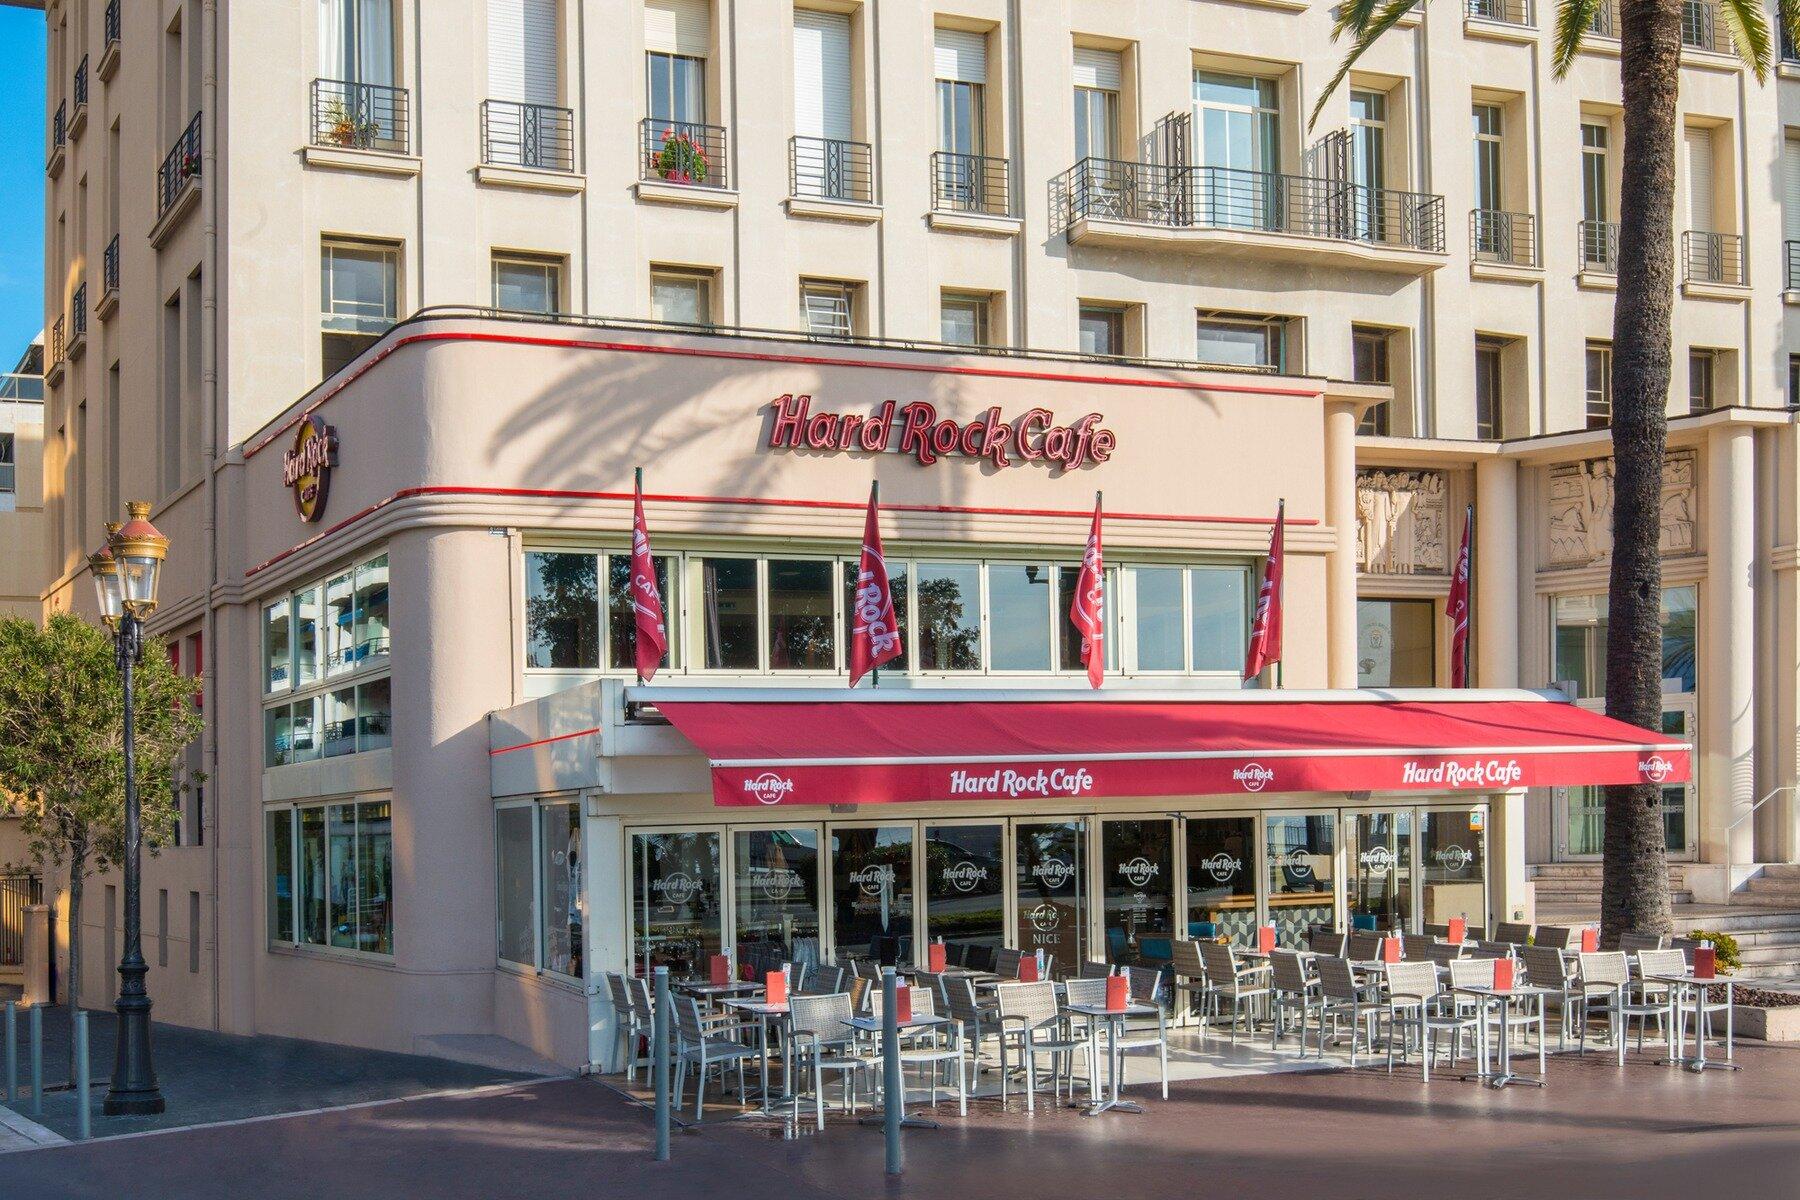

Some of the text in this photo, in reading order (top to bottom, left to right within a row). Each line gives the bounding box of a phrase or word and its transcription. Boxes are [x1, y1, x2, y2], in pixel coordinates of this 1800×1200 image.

[770, 394, 1116, 470] Hard Rock Cafe
[1233, 769, 1274, 781] Hard Rock
[1403, 759, 1521, 787] Hard Rock Cafe
[744, 778, 793, 792] Hard Rock
[950, 767, 1093, 797] Hard Rock Cafe
[1361, 852, 1380, 863] Hard
[1436, 850, 1454, 861] Hard
[1032, 863, 1075, 877] Hard Rock
[1118, 862, 1159, 875] Hard Rock
[1201, 858, 1242, 871] Hard Rock
[849, 868, 896, 883] Hard Rock
[943, 866, 988, 880] Hard Rock
[652, 877, 704, 892] Hard Rock
[1033, 933, 1061, 944] NICE
